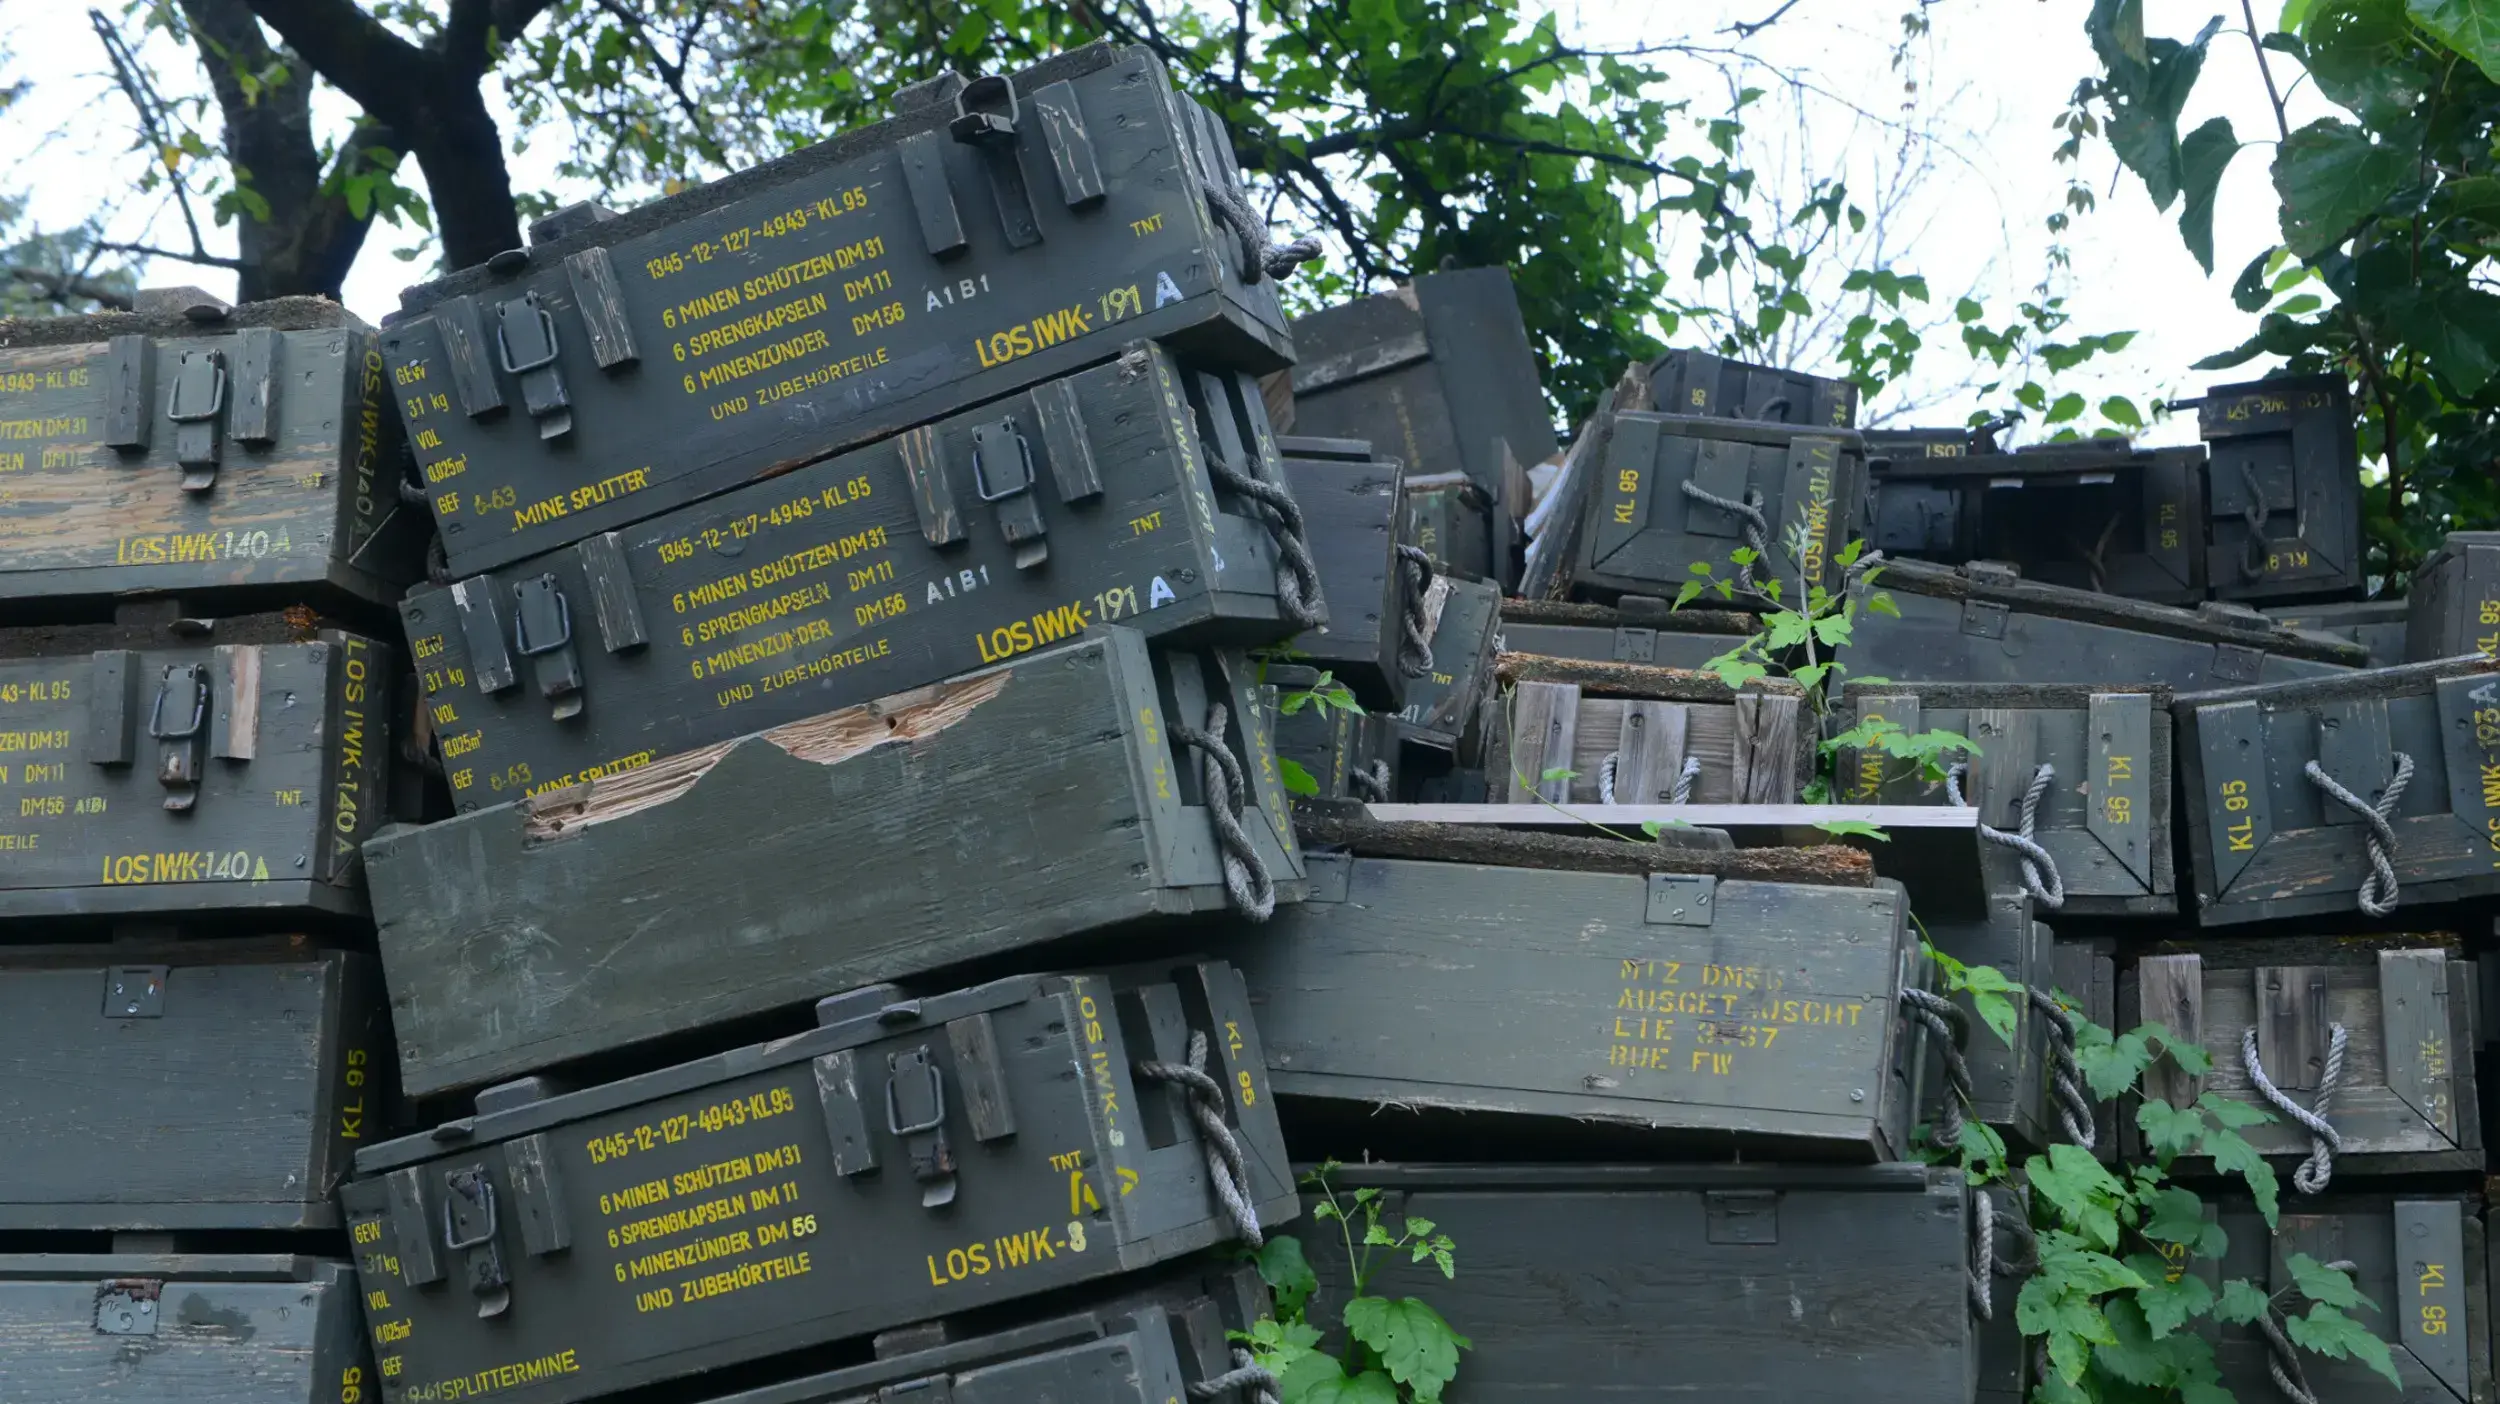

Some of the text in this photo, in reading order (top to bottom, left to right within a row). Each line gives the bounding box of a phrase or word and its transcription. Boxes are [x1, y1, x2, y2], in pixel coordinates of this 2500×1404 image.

[1129, 212, 1164, 238] TNT
[662, 308, 677, 329] 6
[678, 286, 741, 324] MINEN
[743, 253, 836, 302] SCHÜTZEN
[1155, 270, 1185, 310] A
[672, 342, 686, 362] 6
[689, 292, 828, 357] SPRENGKAPSELN
[395, 363, 426, 386] GEW
[683, 375, 697, 394] 6
[699, 329, 830, 390] MINENZÜNDER
[710, 346, 890, 421] UND ZUBEHÖRTEILE
[407, 392, 449, 418] 31 kg
[416, 428, 443, 451] VOL
[437, 492, 461, 515] GEF
[1614, 470, 1639, 524] KL 95
[1129, 512, 1161, 535] TNT
[672, 594, 686, 614] 6
[688, 573, 748, 609] MINEN
[750, 541, 839, 588] SCHÜTZEN
[2265, 554, 2279, 572] 9
[1150, 575, 1175, 609] A
[681, 627, 694, 646] 6
[698, 582, 831, 643] SPRENGKAPSELN
[415, 634, 443, 658] GEW
[692, 661, 703, 680] 6
[707, 618, 833, 678] MINENZÜNDER
[345, 638, 367, 703] LOS
[425, 668, 466, 692] 31 kg
[718, 639, 892, 708] UND ZUBEHÖRTEILE
[1432, 671, 1453, 686] TNT
[2468, 681, 2499, 704] A
[434, 704, 459, 724] VOL
[452, 768, 474, 790] GEF
[2107, 756, 2131, 825] KL 95
[275, 789, 301, 807] TNT
[2222, 779, 2254, 852] KL 95
[335, 834, 355, 855] A
[103, 854, 150, 884] LOS
[251, 856, 269, 887] A
[1074, 977, 1105, 1044] LOS
[1224, 1021, 1256, 1106] KL 95
[1692, 1051, 1733, 1075] FW
[341, 1048, 366, 1139] KL 95
[1049, 1150, 1081, 1173] TNT
[599, 1195, 612, 1215] 6
[612, 1179, 670, 1212] MINEN
[673, 1157, 752, 1195] SCHÜTZEN
[355, 1220, 382, 1244] GEW
[608, 1229, 619, 1248] 6
[621, 1195, 746, 1245] SPRENGKAPSELN
[615, 1263, 626, 1282] 6
[629, 1231, 753, 1280] MINENZÜNDER
[927, 1243, 991, 1286] LOS
[636, 1252, 812, 1313] UND ZUBEHÖRTEILE
[2420, 1264, 2445, 1297] KL
[368, 1291, 391, 1311] VOL
[383, 1356, 402, 1377] GEF
